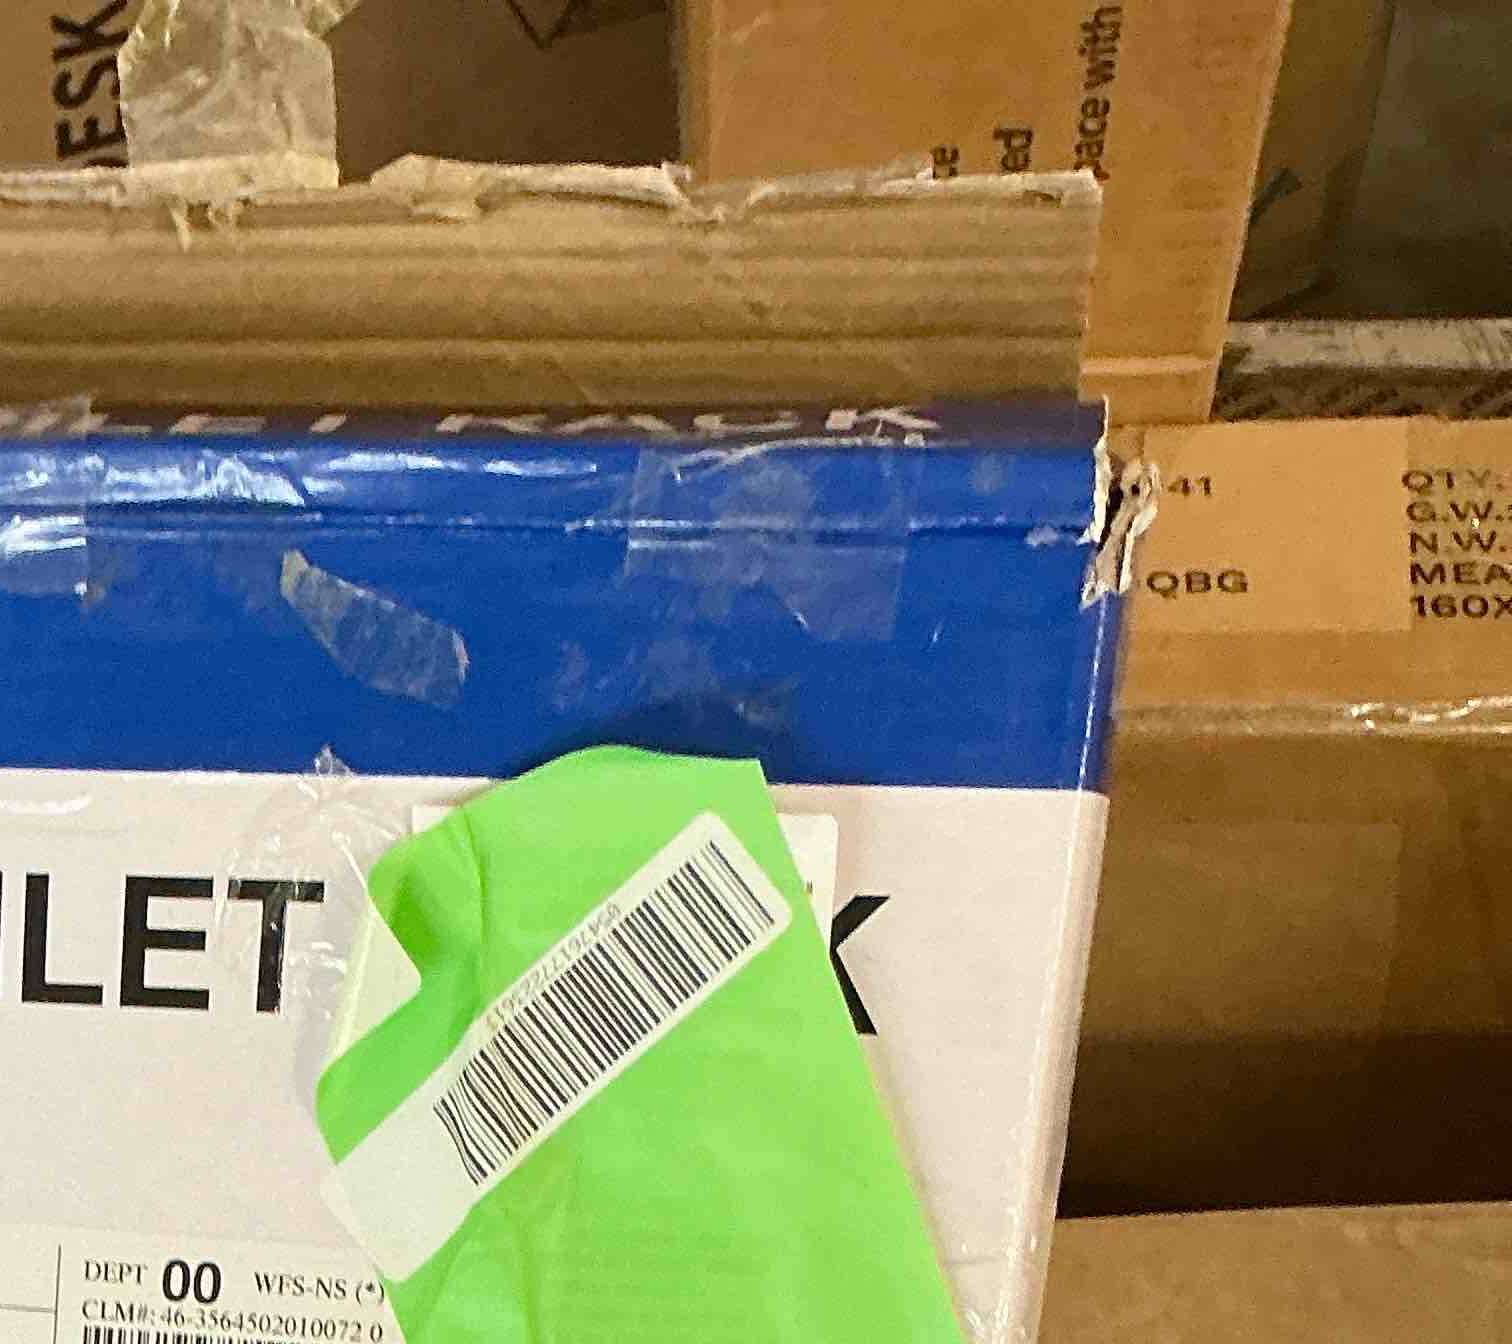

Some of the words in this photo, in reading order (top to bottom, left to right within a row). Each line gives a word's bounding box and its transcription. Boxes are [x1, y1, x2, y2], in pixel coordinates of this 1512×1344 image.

[50, 0, 131, 168] ESK
[1079, 6, 1122, 89] with
[84, 1260, 148, 1286] DEPT
[161, 1259, 223, 1304] 00
